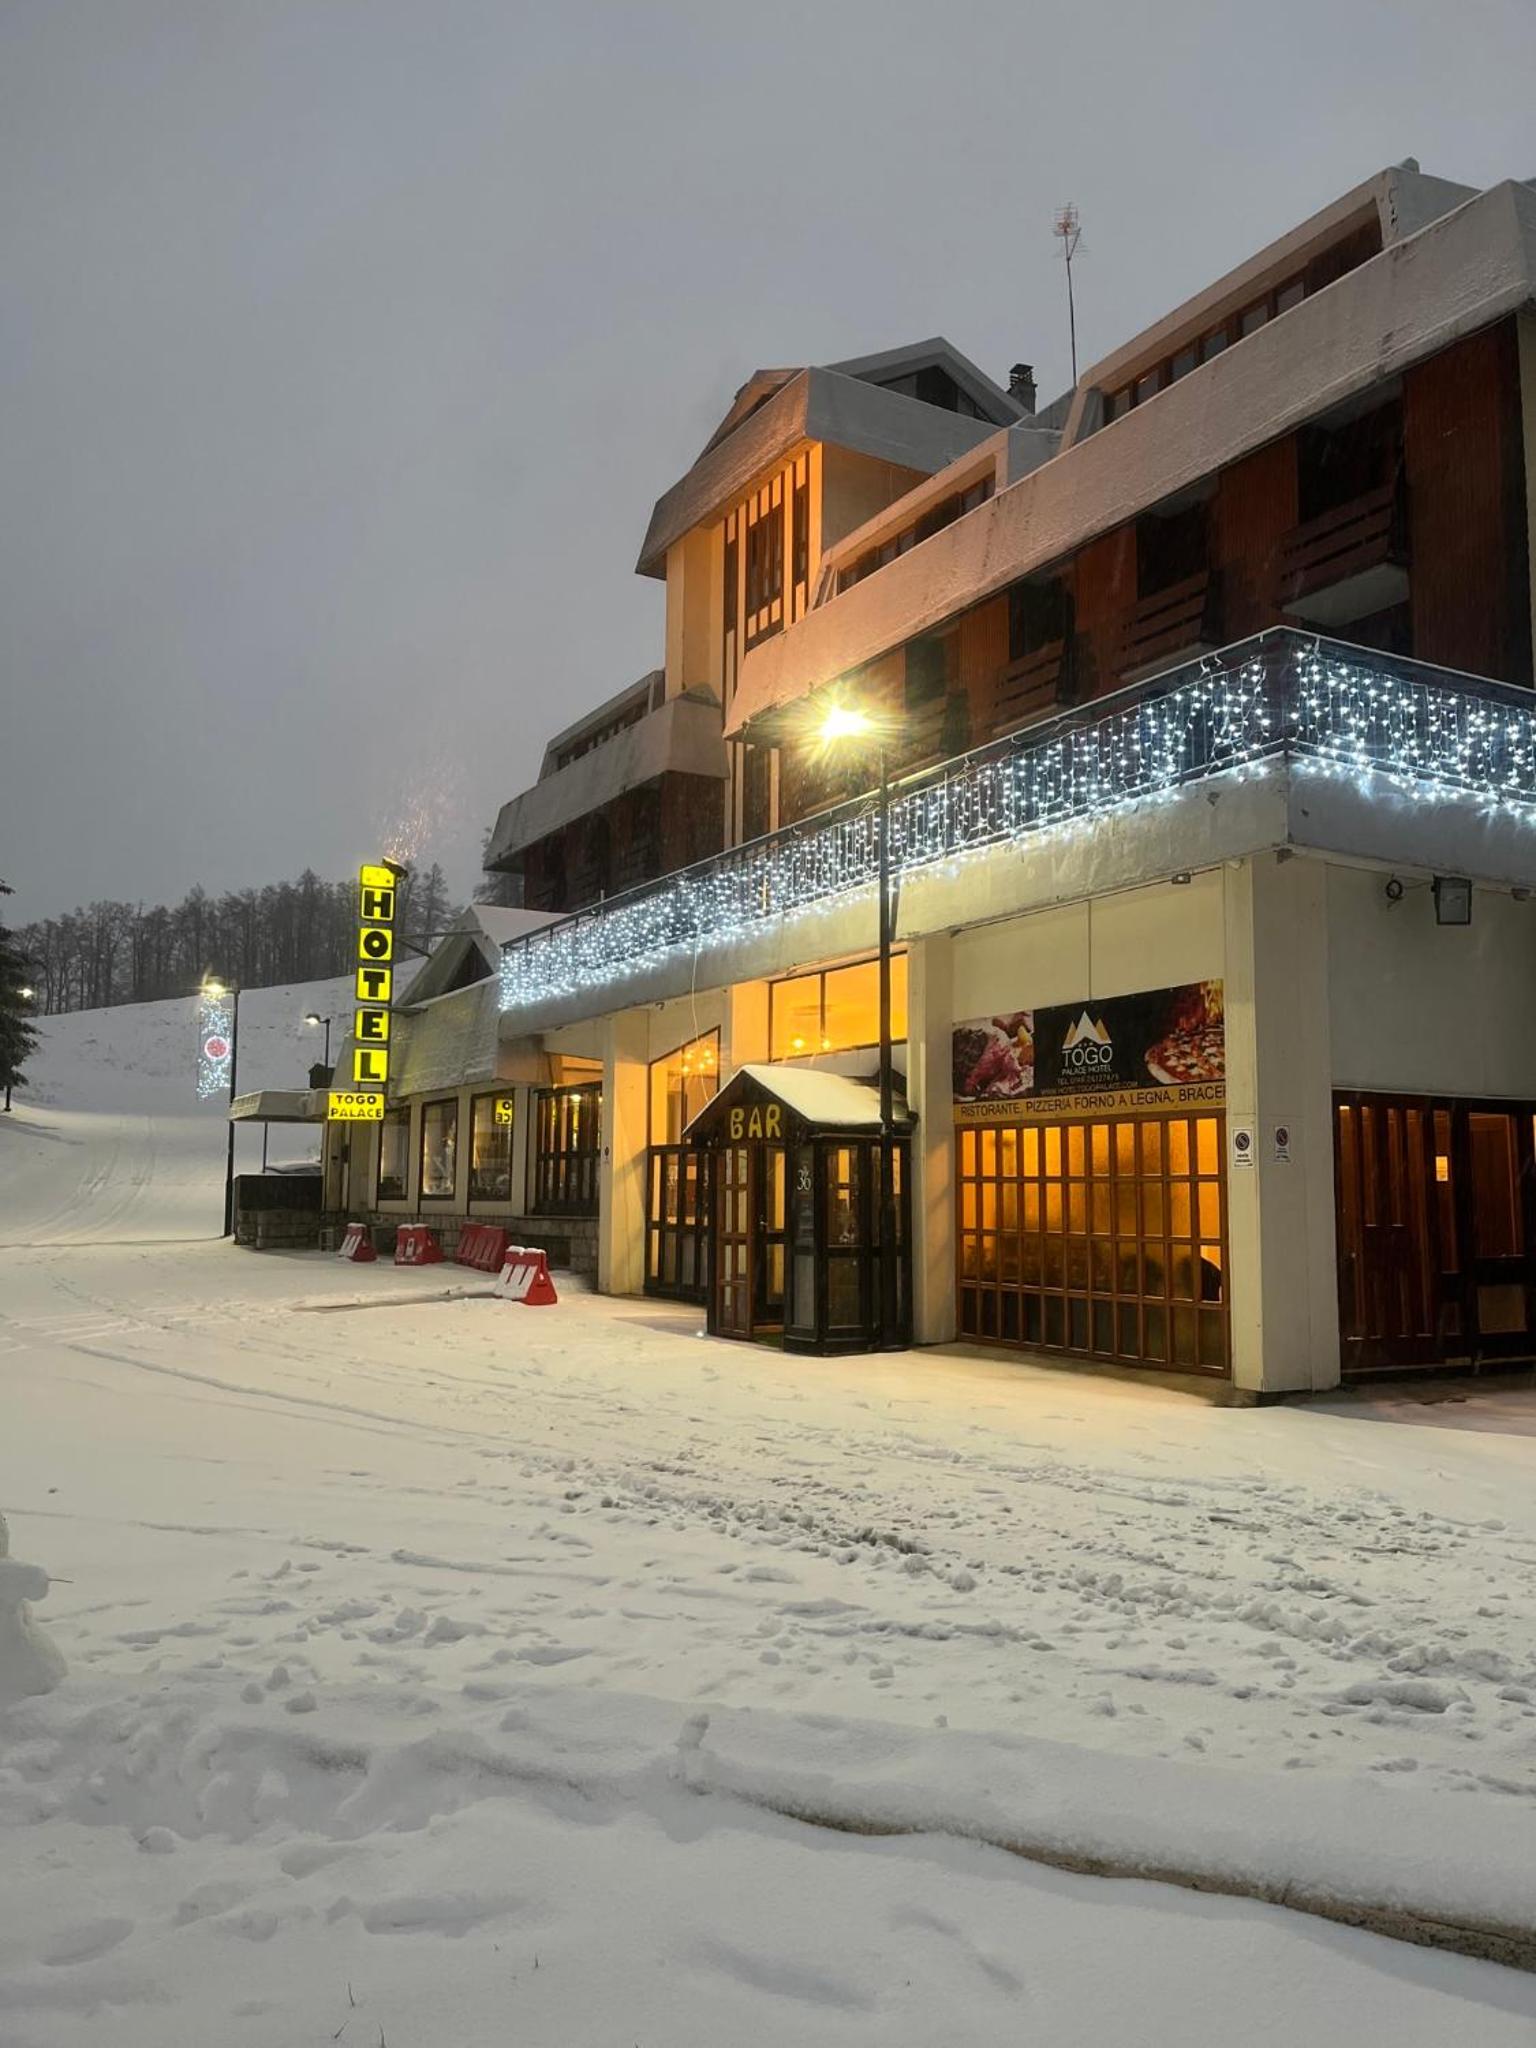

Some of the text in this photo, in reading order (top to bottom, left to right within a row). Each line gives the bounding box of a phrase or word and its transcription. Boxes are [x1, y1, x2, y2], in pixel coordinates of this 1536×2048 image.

[360, 890, 391, 1080] HOTEL
[1061, 1045, 1113, 1067] TOGO
[1062, 1064, 1112, 1076] PALACE HOTEL
[336, 1095, 377, 1104] TOGO
[1026, 1097, 1072, 1113] PIZZERIA
[1074, 1094, 1115, 1109] FORNO
[1118, 1094, 1128, 1106] A
[331, 1108, 382, 1118] PALACE
[730, 1103, 782, 1139] BAR
